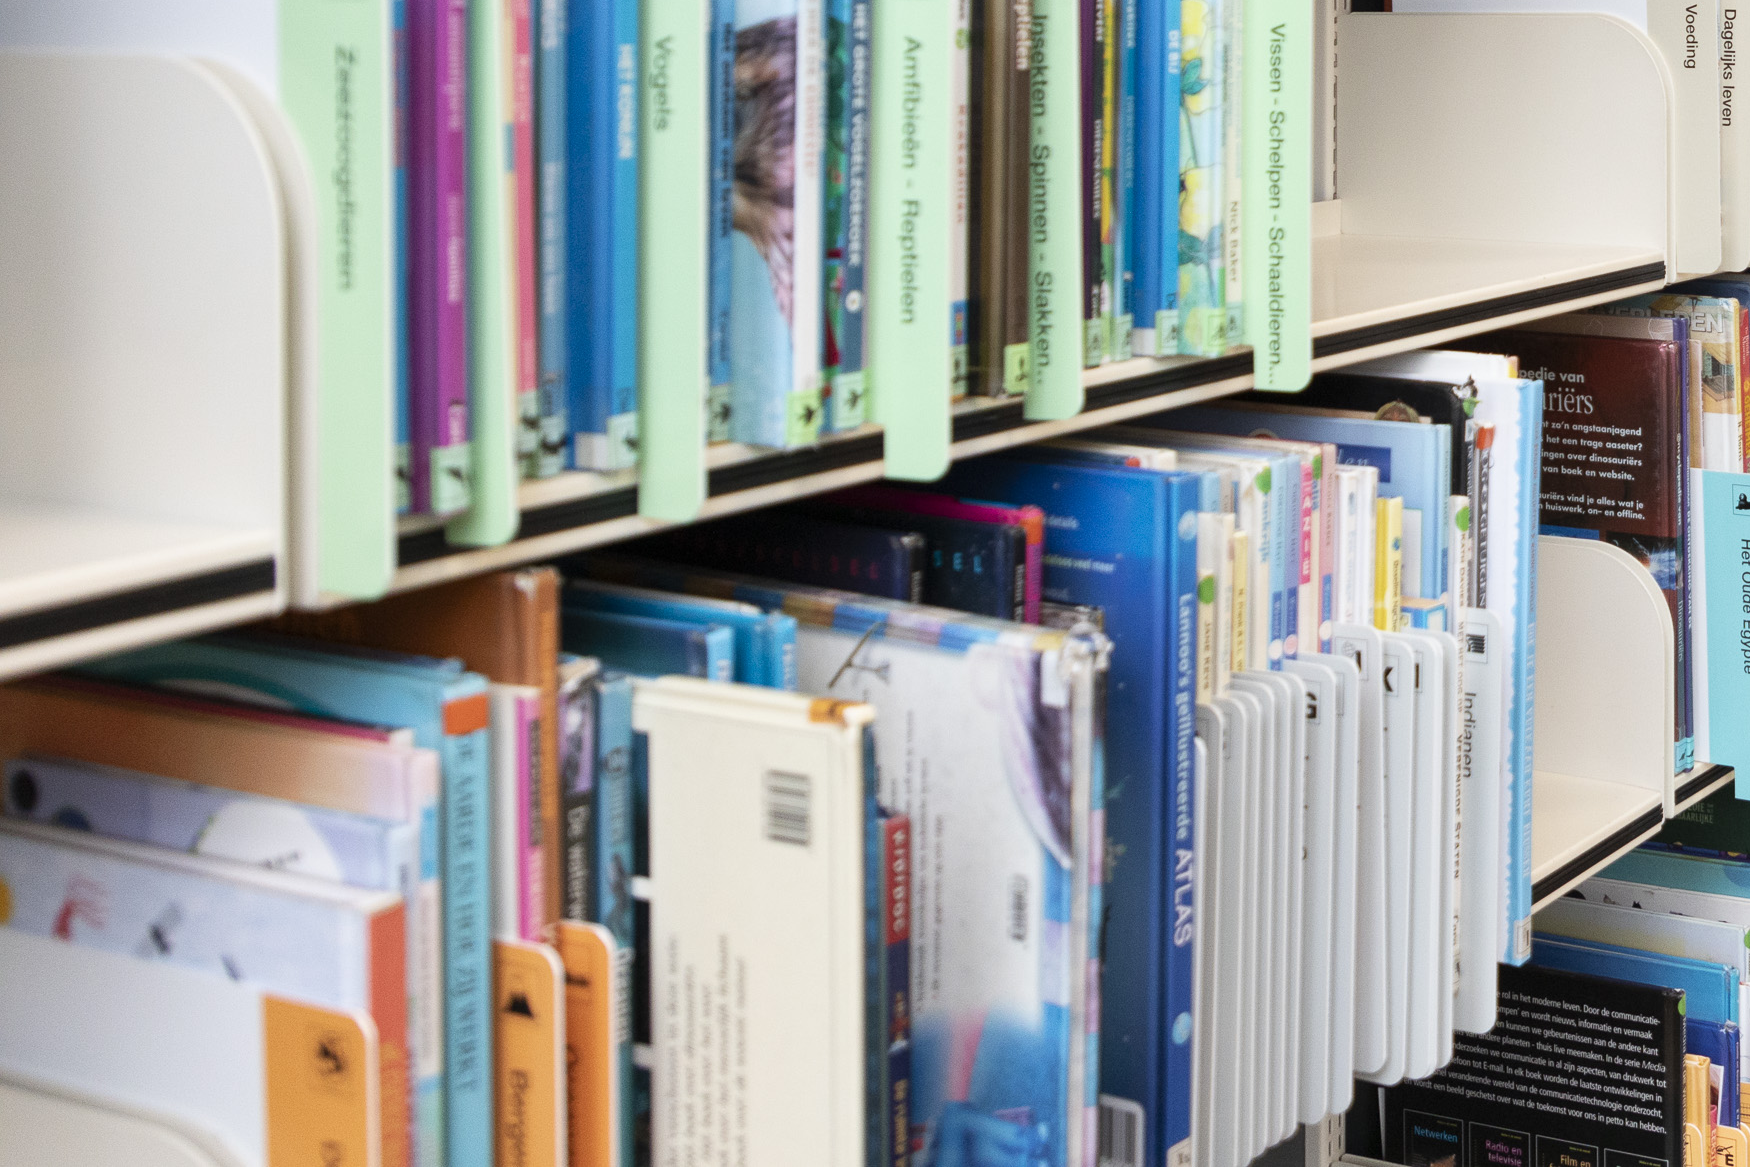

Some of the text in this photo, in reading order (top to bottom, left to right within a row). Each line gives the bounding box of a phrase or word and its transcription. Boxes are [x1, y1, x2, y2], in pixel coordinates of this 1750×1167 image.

[851, 3, 868, 109] HET GROTE
[1168, 29, 1180, 74] DE BIJ
[1682, 3, 1699, 70] Voeding
[1268, 23, 1286, 94] Vissen
[1719, 8, 1737, 127] Dagelijks leven
[649, 35, 675, 131] Vogels
[1030, 14, 1051, 243] Insekten Spinnen
[333, 43, 356, 291] Zeezoogdieren
[899, 36, 922, 323] Amfibieën Reptielen
[1265, 110, 1285, 210] Schelpen
[1229, 200, 1240, 283] Nick Baker
[1559, 372, 1585, 383] van
[1546, 435, 1643, 452] het een trage aaseter?
[1551, 421, 1642, 438] zo'n angstaanjagend
[1561, 466, 1583, 476] boek
[1598, 468, 1635, 481] website.
[1567, 452, 1643, 467] over dinosauriërs
[1545, 502, 1646, 521] huiswerk, offline.
[1566, 493, 1634, 507] vind alles wat
[1476, 510, 1488, 609] GETUIGEN
[1178, 593, 1193, 687] Lannoo's
[1460, 691, 1477, 779] Indianen
[567, 805, 590, 834] De
[1453, 733, 1463, 880] VERENIGDE STATEN
[1173, 848, 1194, 947] ATLAS
[1532, 996, 1661, 1026] moderne communicatie-
[1552, 1014, 1652, 1040] nieuws, informatie vermaak
[1502, 1034, 1604, 1061] planeten meemaken.
[1543, 1027, 1592, 1044] gebeurtenissen
[1483, 1061, 1654, 1101] E-mail. laatste ontwikkelingen
[1501, 1049, 1655, 1086] communicatie aspecten, drukwerk
[1448, 1069, 1663, 1118] veranderende communicatietechnologie onderzocht,
[1465, 1088, 1667, 1134] geschetst toekomst hebben.
[1414, 1125, 1458, 1143] Netwerken
[1485, 1139, 1522, 1156] Radio en
[1488, 1152, 1522, 1166] televisie
[1560, 1154, 1578, 1166] Film
